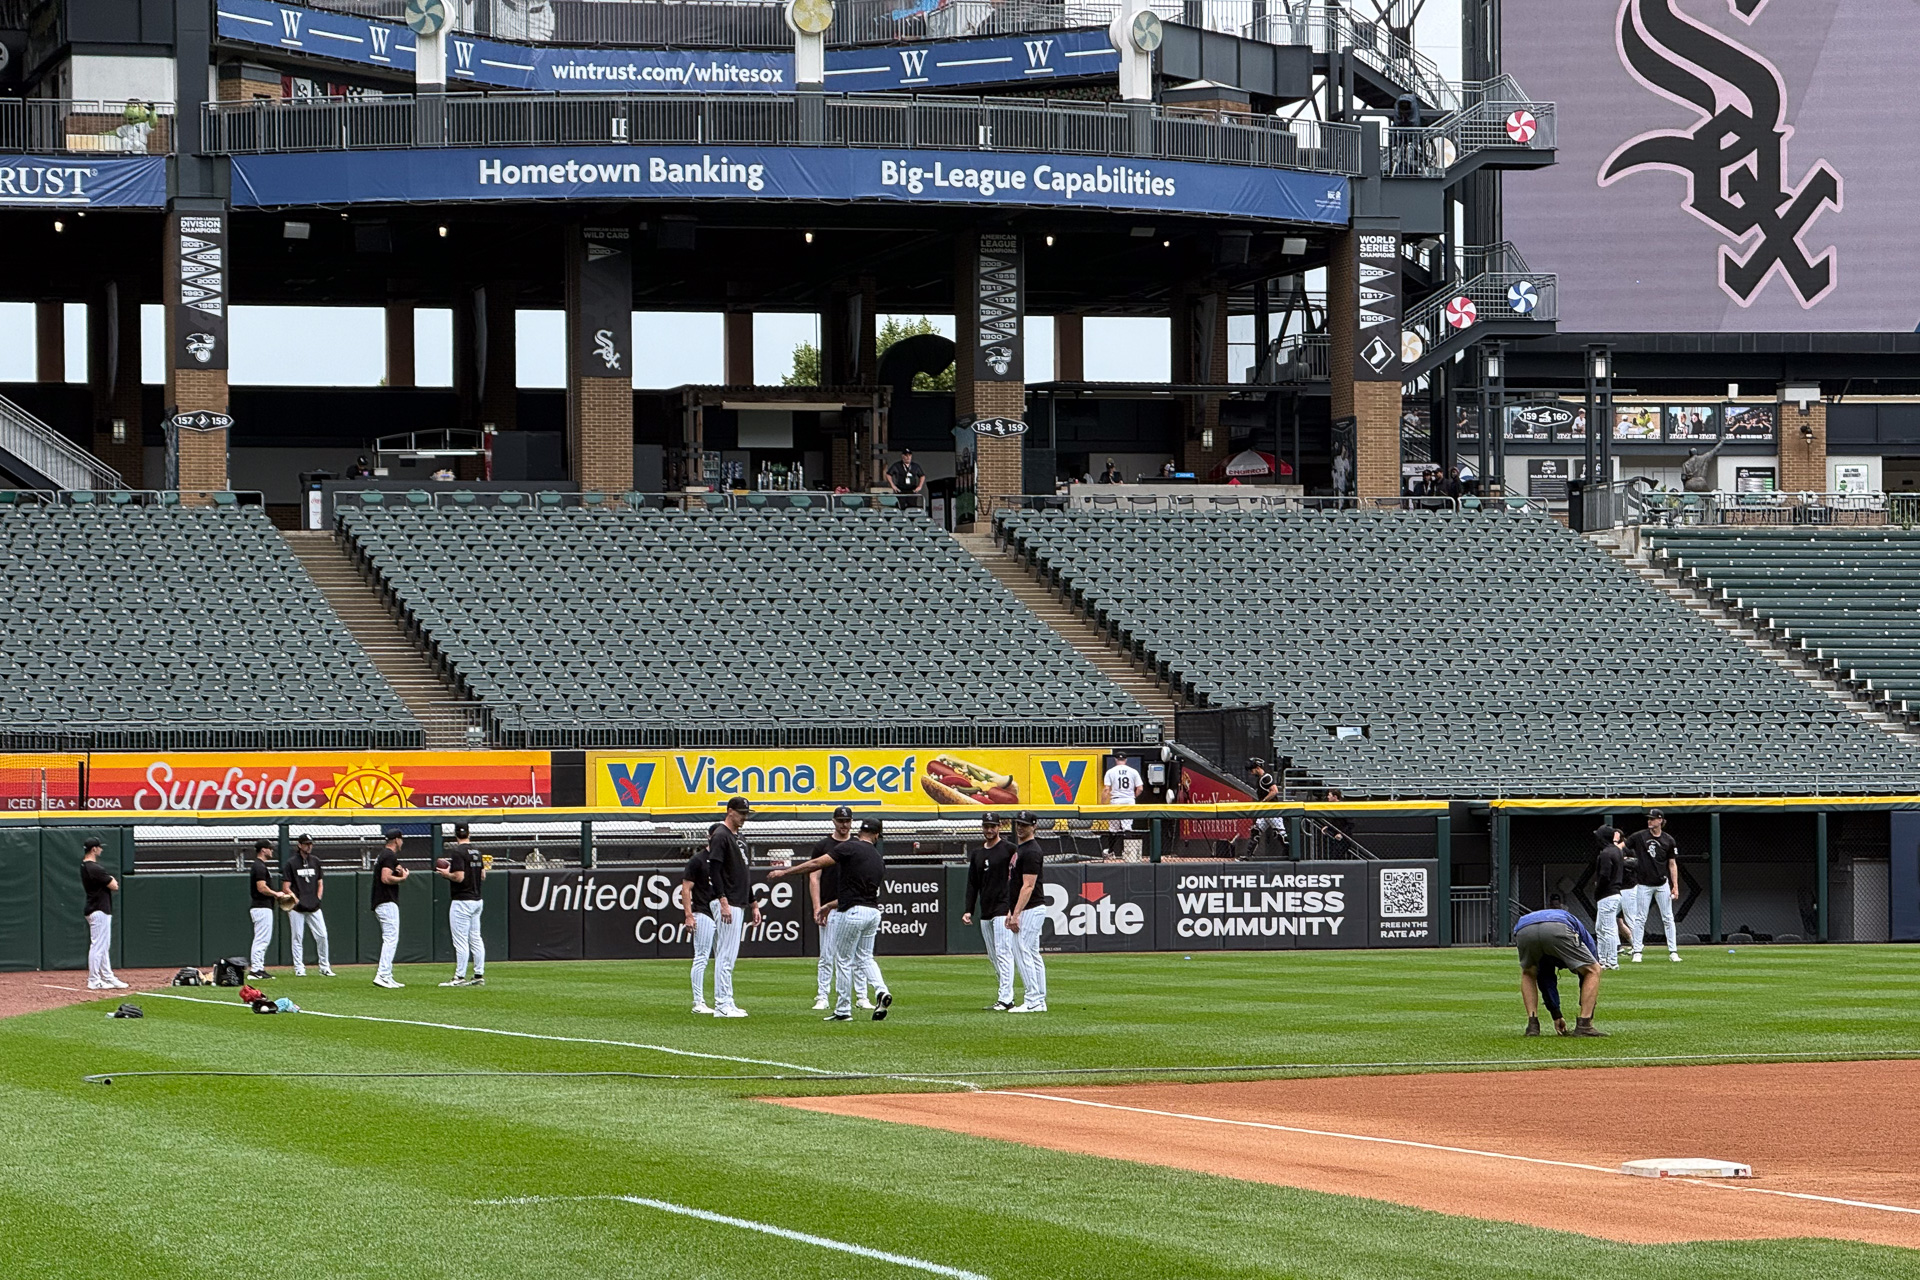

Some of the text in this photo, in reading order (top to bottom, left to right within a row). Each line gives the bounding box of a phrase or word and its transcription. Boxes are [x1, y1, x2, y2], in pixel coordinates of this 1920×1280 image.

[280, 9, 303, 39] W
[369, 26, 390, 55] W
[454, 41, 475, 69] W
[1024, 40, 1053, 67] W
[552, 60, 784, 84] wintrust.com/whitesox
[900, 50, 928, 77] W
[479, 155, 764, 191] Hometown Banking
[881, 160, 1176, 199] Big-League Capabilities
[180, 220, 221, 228] DIVISION
[583, 231, 605, 239] WILD
[1359, 235, 1396, 244] WORLD
[1359, 243, 1396, 252] SERIES
[177, 416, 228, 425] 157 158
[1523, 412, 1568, 421] 159 160
[977, 423, 992, 431] 158
[1008, 423, 1024, 432] 159
[675, 755, 916, 794] Vienna Beef
[1117, 776, 1130, 789] 18
[133, 761, 317, 810] Surfside
[8, 798, 36, 809] ICED
[40, 799, 65, 809] EA
[83, 798, 122, 809] ODKA
[425, 795, 489, 806] LEMONADE
[502, 795, 543, 806] VODKA
[884, 880, 939, 894] Venues
[1177, 874, 1345, 889] JOIN THE LARGEST
[520, 874, 794, 912] UnitedSece
[911, 899, 939, 913] and
[1039, 883, 1145, 937] Rate
[1176, 891, 1345, 914] WELLNESS
[1176, 917, 1345, 937] COMMUNITY
[1380, 930, 1428, 938] RATE APP
